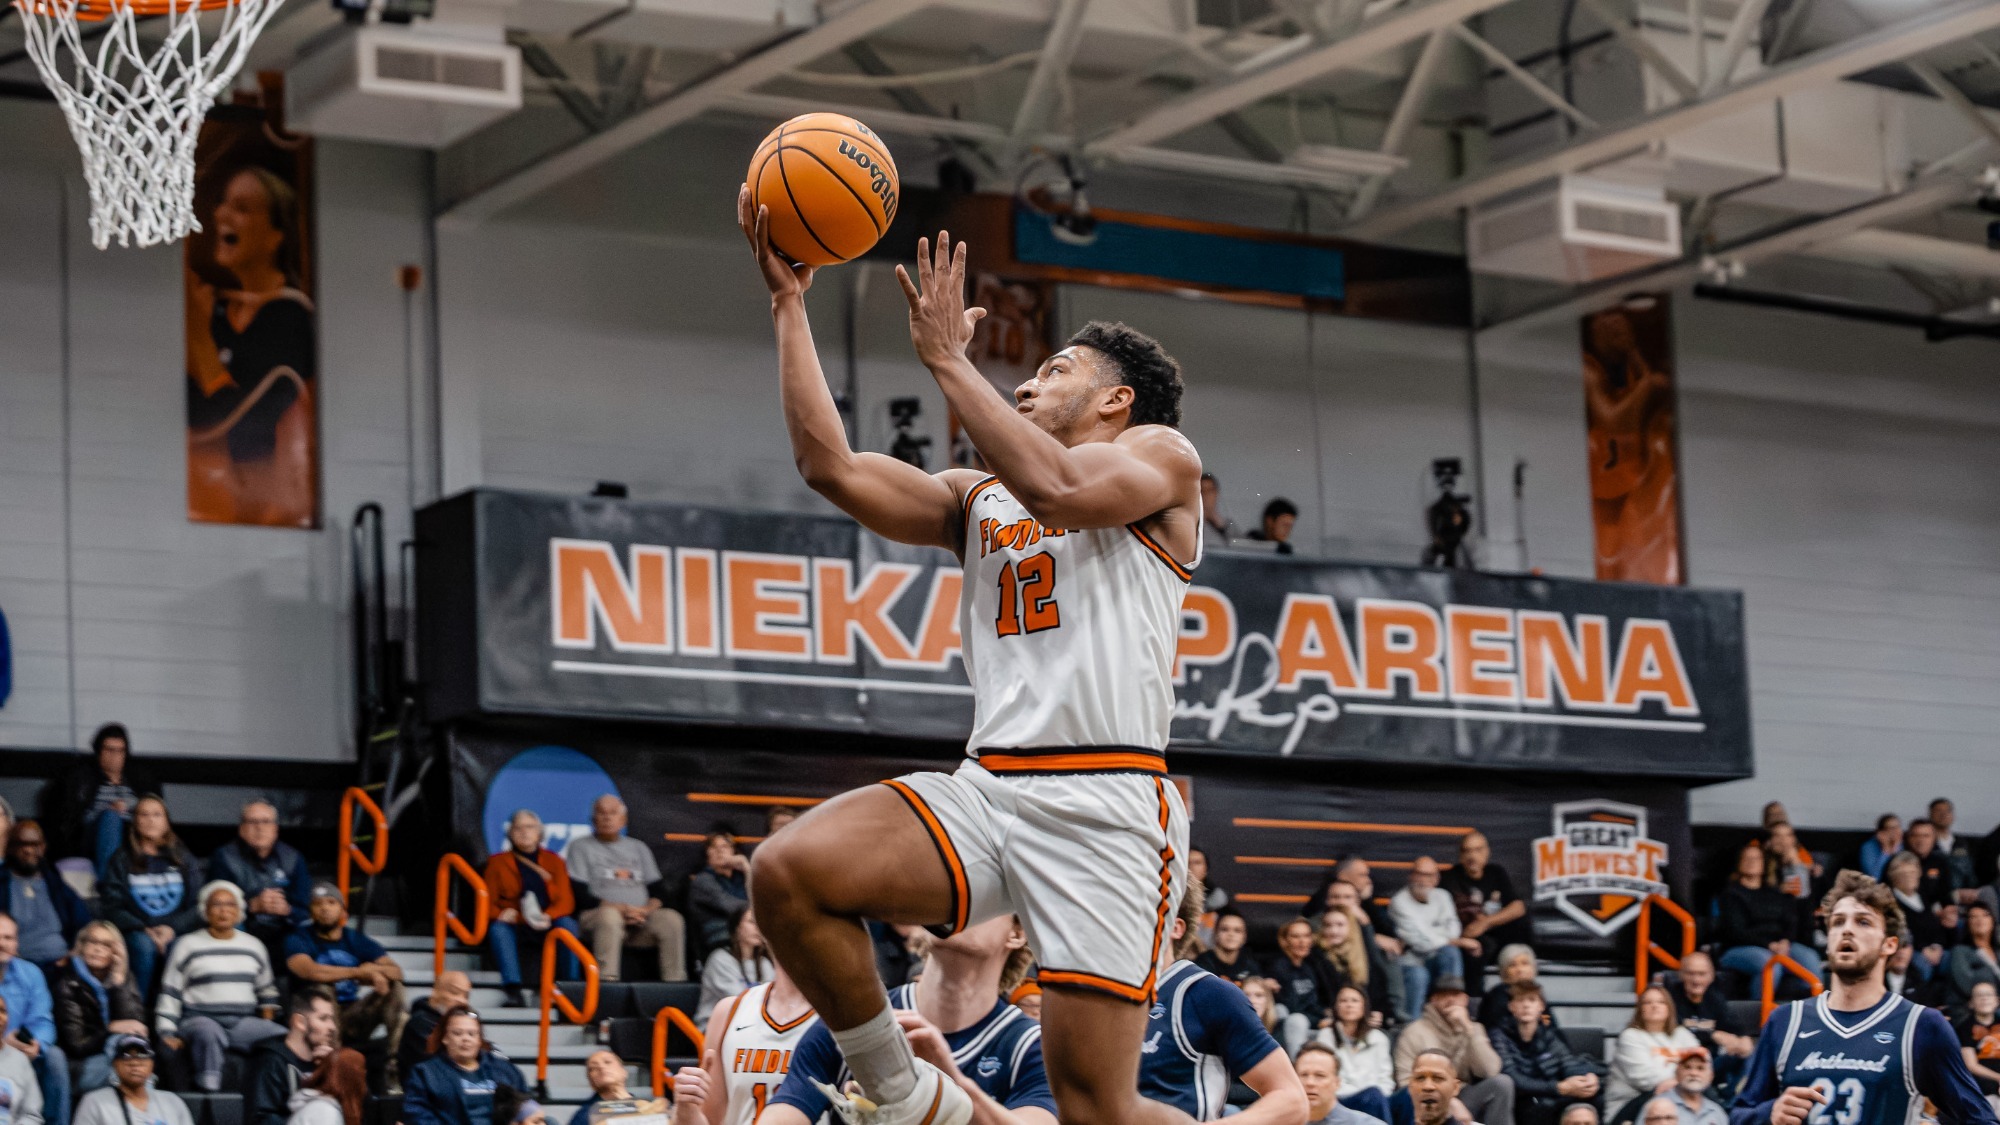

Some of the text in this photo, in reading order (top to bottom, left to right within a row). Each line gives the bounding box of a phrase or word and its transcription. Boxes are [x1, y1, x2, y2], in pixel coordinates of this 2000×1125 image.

[838, 139, 897, 225] Wilson
[995, 550, 1060, 638] 12
[1274, 593, 1701, 715] ARENA
[1795, 1051, 1891, 1073] Northwood
[1807, 1077, 1866, 1125] 23
